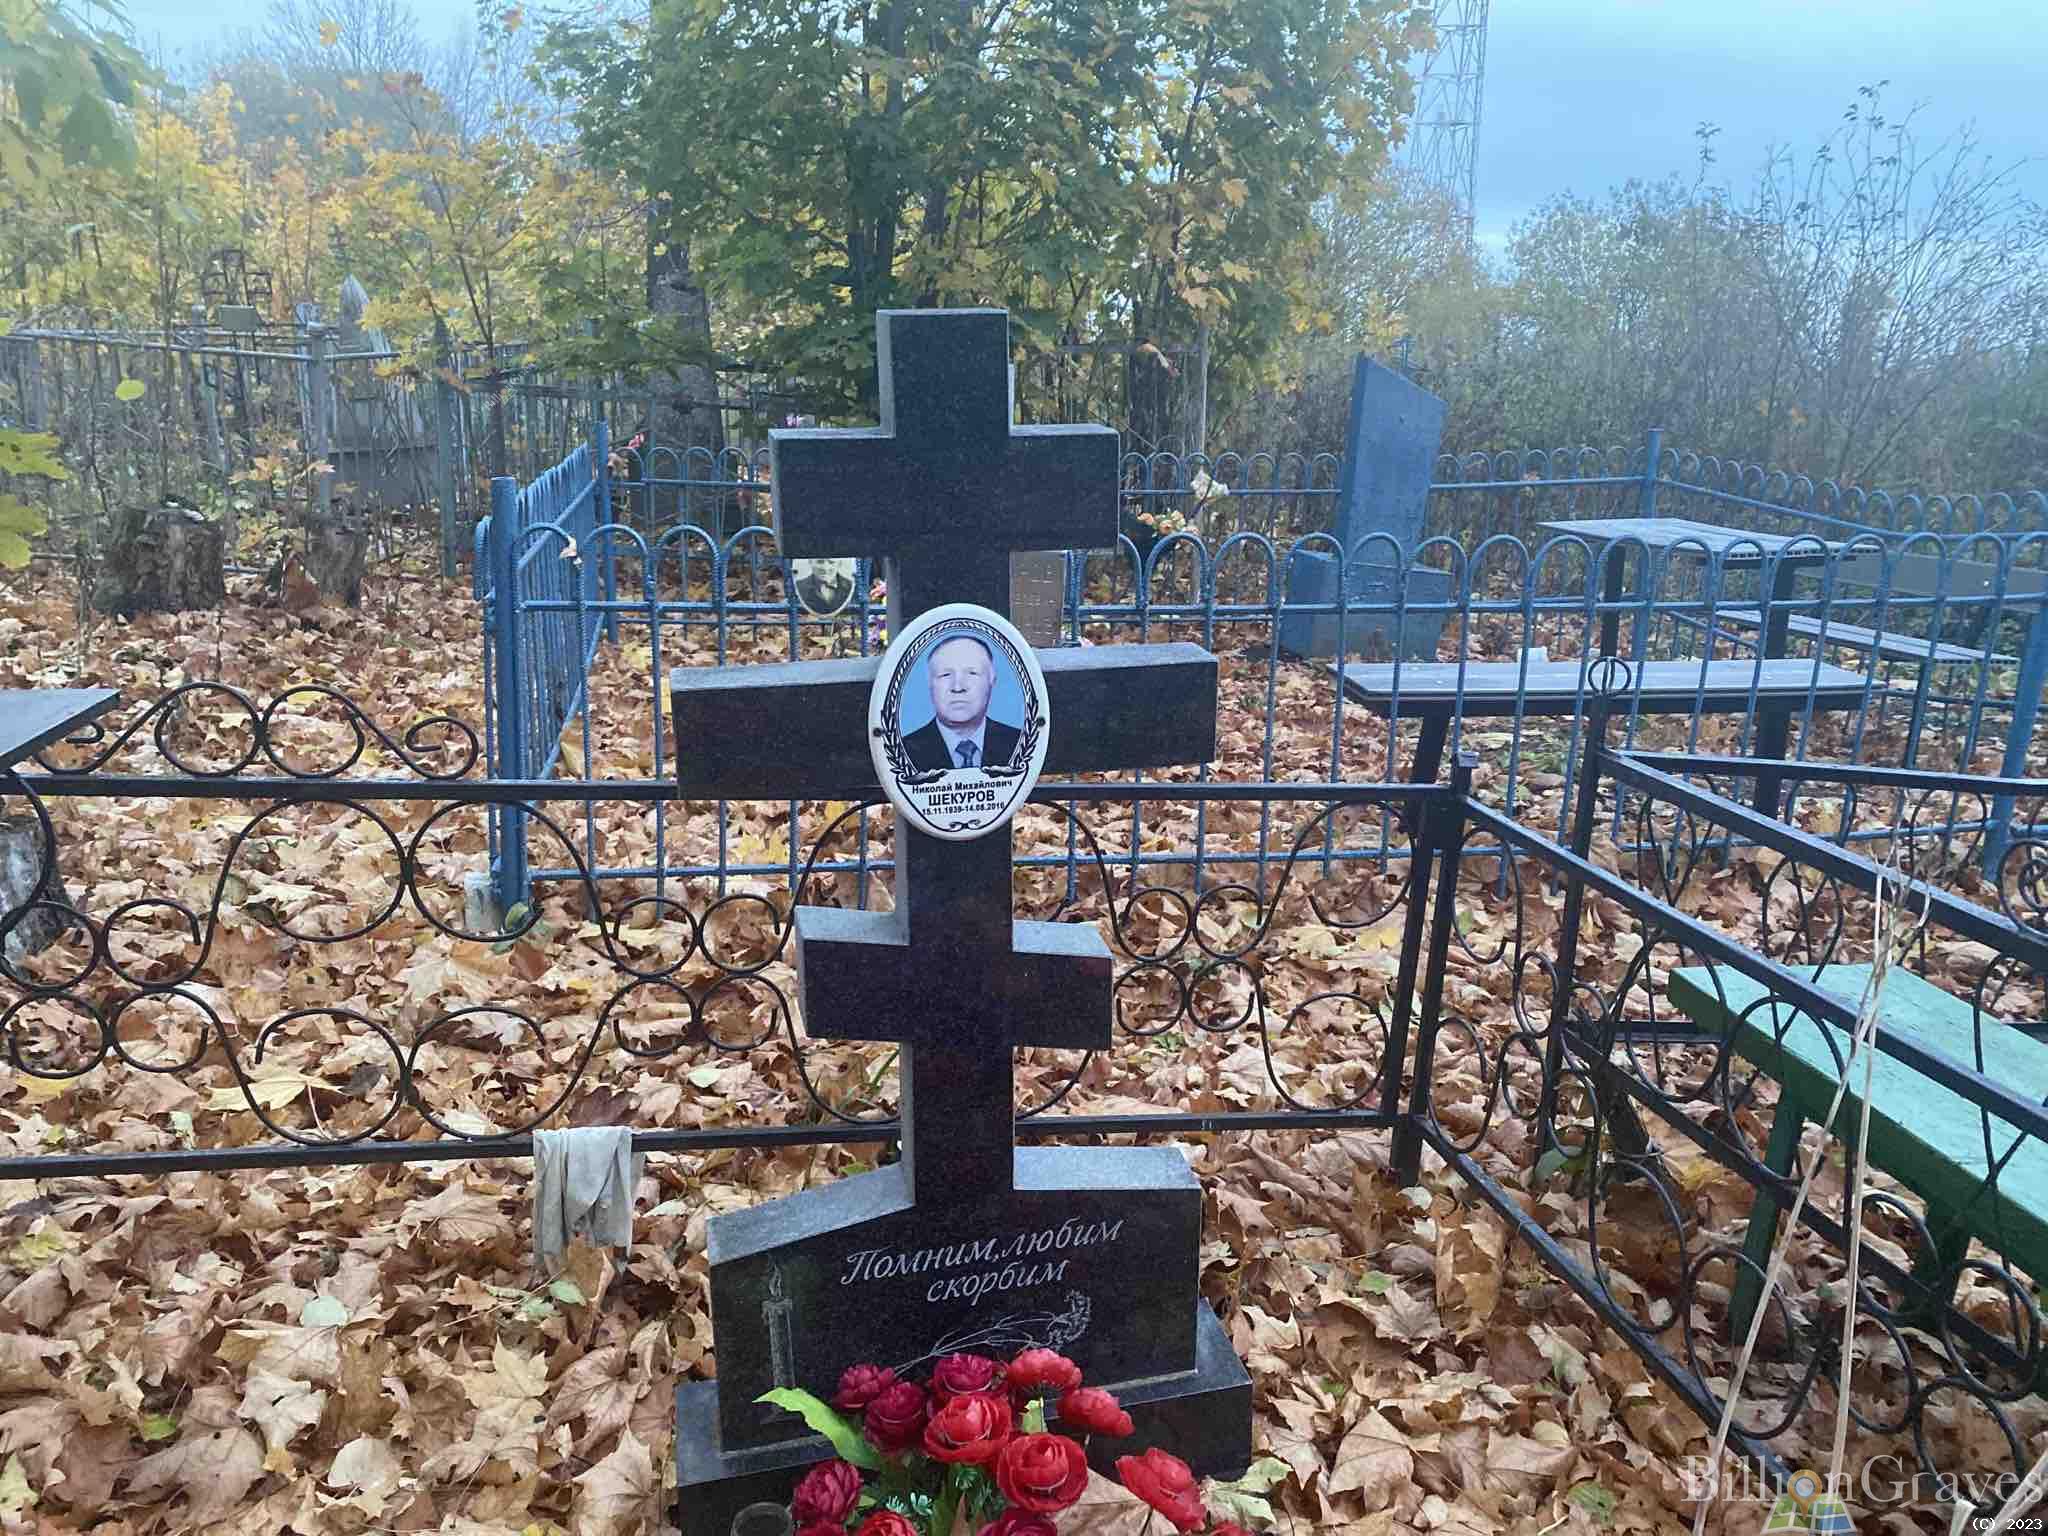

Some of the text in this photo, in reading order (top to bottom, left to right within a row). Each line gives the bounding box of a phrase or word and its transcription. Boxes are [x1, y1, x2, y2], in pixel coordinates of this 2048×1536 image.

[912, 779, 1013, 794] Николай Михайлович
[928, 789, 995, 806] ШЕКУРОВ
[927, 1259, 1070, 1306] скорбим
